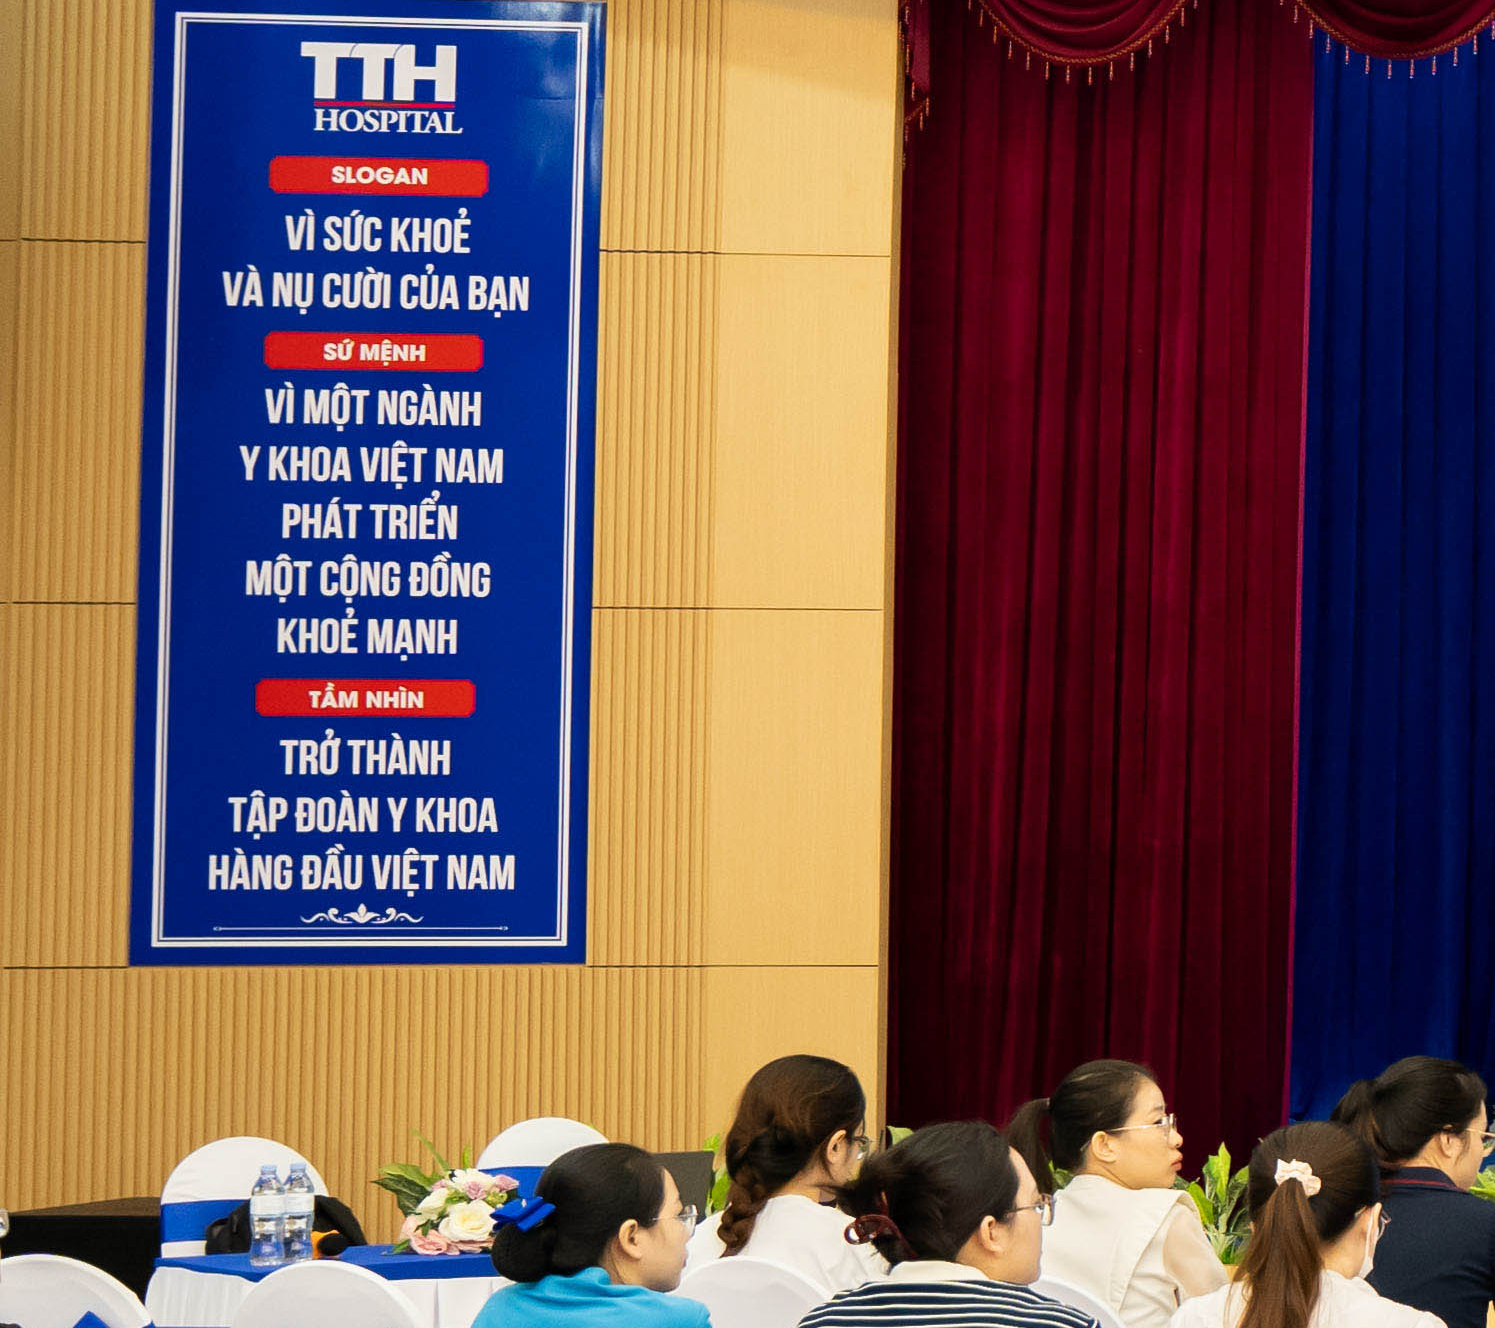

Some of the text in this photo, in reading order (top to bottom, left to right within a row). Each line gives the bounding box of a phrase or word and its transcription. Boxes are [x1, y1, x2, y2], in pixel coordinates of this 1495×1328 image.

[300, 41, 457, 102] TTH
[314, 108, 463, 134] HOSPITAL
[331, 165, 428, 185] SLOGAN
[285, 207, 472, 254] VÌ SỨC KHOẺ
[222, 263, 530, 318] VÀ NỤ CƯỜI CỦA BẠN
[323, 338, 426, 366] SỨ MỆNH
[265, 381, 482, 432] VÌ MỘT NGÀNH
[239, 440, 504, 490] Y KHOA VIỆT NAM
[282, 489, 458, 540] PHÁT TRIỂN
[245, 551, 491, 604] MỘT CỘNG ĐỒNG
[277, 607, 458, 662] KHOẺ MẠNH
[308, 682, 424, 709] TẦM NHÌN
[279, 728, 451, 776] TRỞ THÀNH
[228, 789, 499, 840] TẬP ĐOÀN Y KHOA
[208, 843, 516, 897] HÀNG ĐẦU VIỆT NAM
